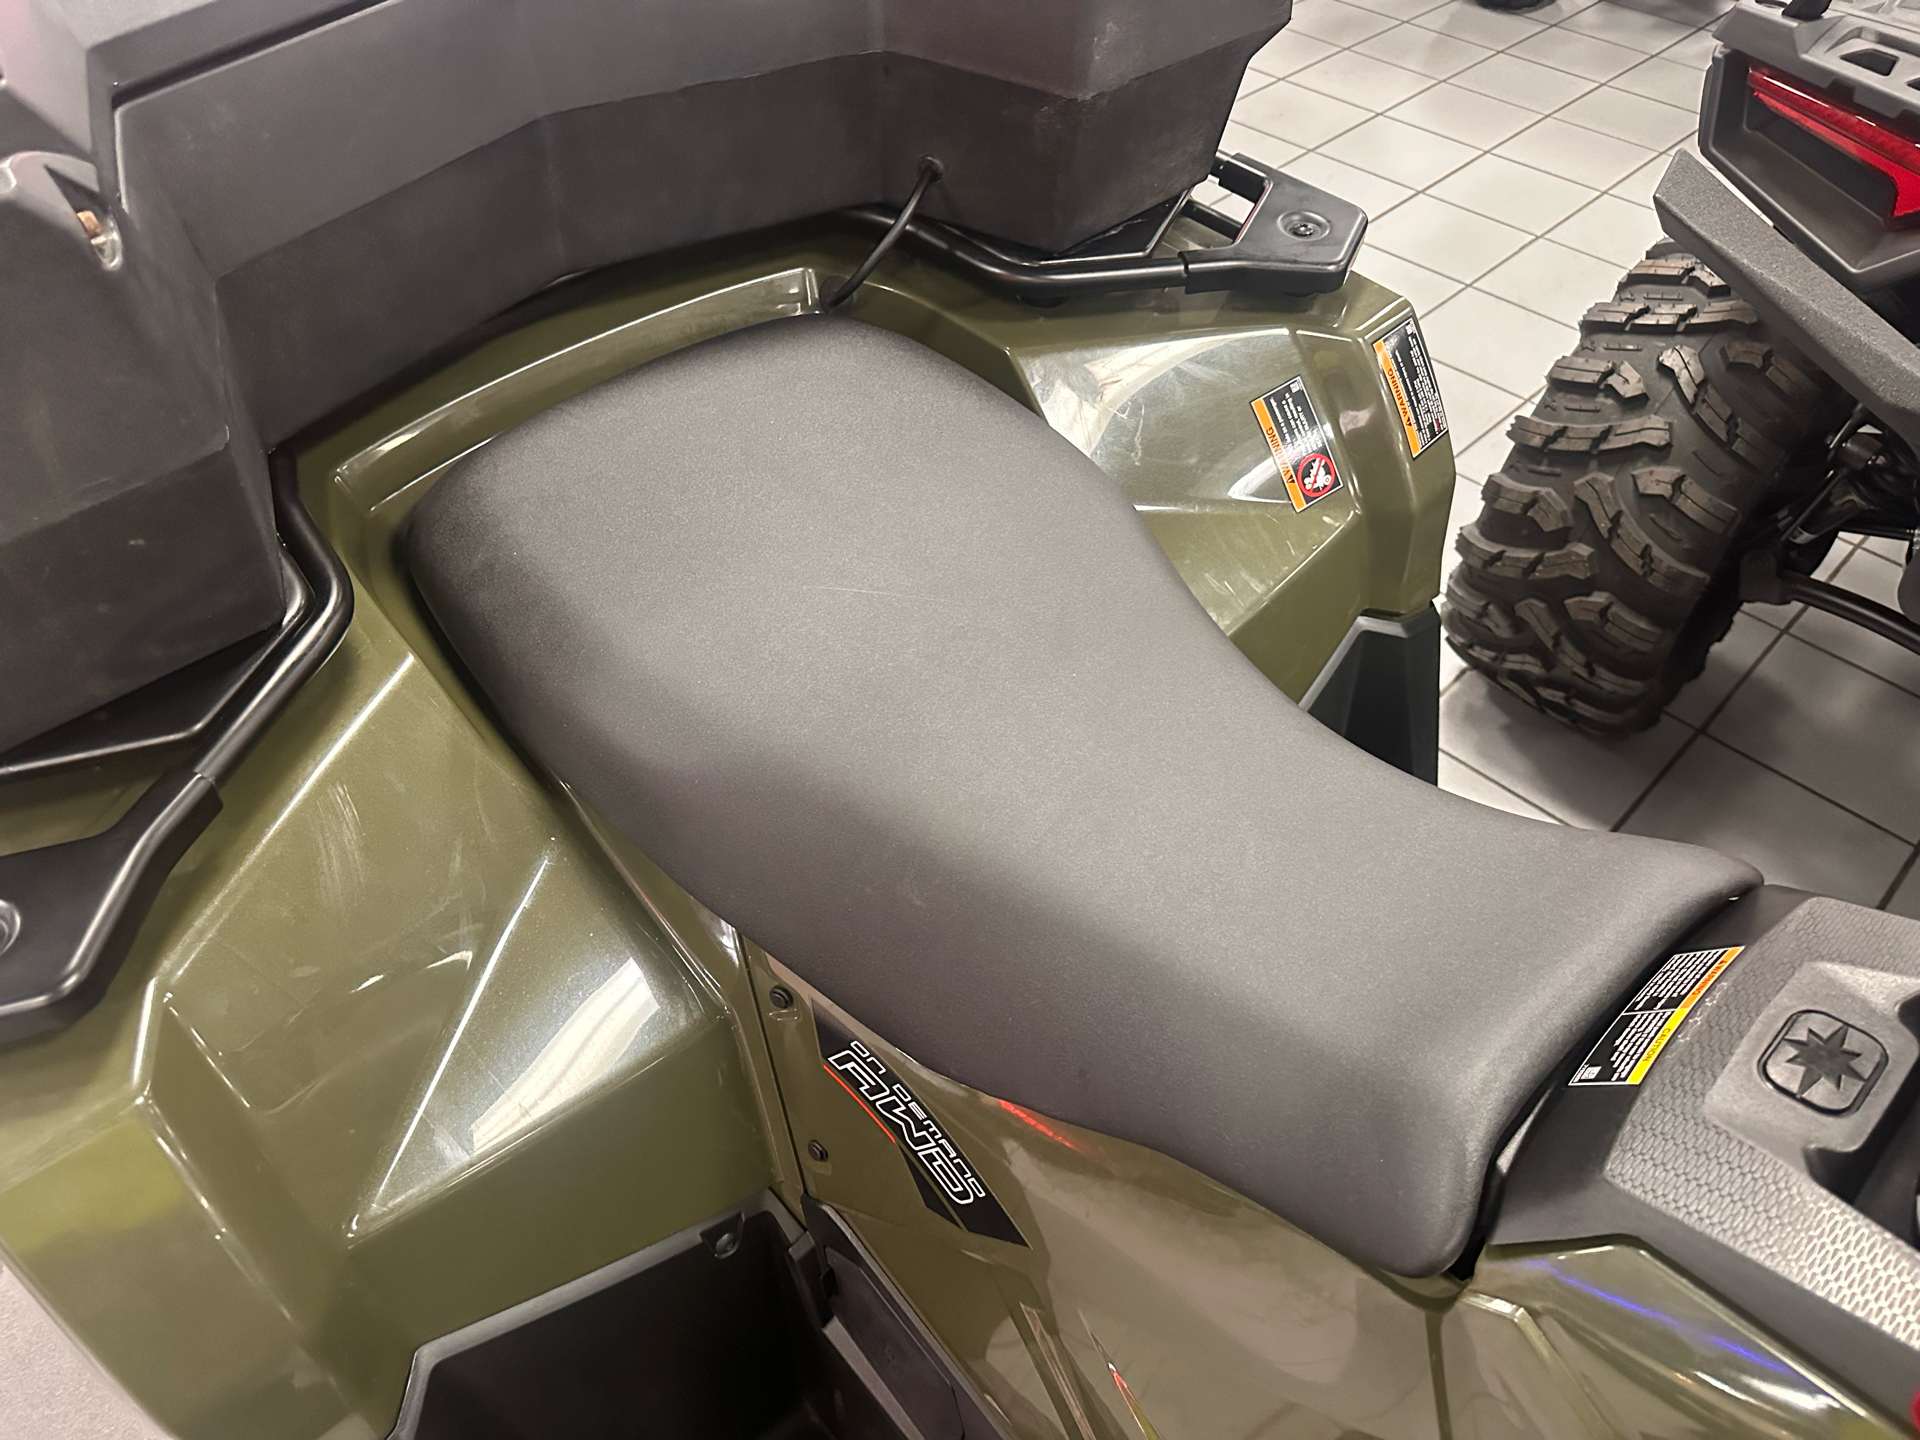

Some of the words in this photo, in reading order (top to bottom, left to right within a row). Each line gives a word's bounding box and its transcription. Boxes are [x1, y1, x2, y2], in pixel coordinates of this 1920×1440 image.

[1387, 367, 1407, 416] WARNING
[1266, 427, 1290, 475] WARNING
[1691, 964, 1722, 995] WARNING
[1642, 1028, 1671, 1061] CAUTION
[828, 1050, 974, 1205] AWD
[850, 1041, 886, 1075] ON
[892, 1084, 986, 1198] DEMAND
